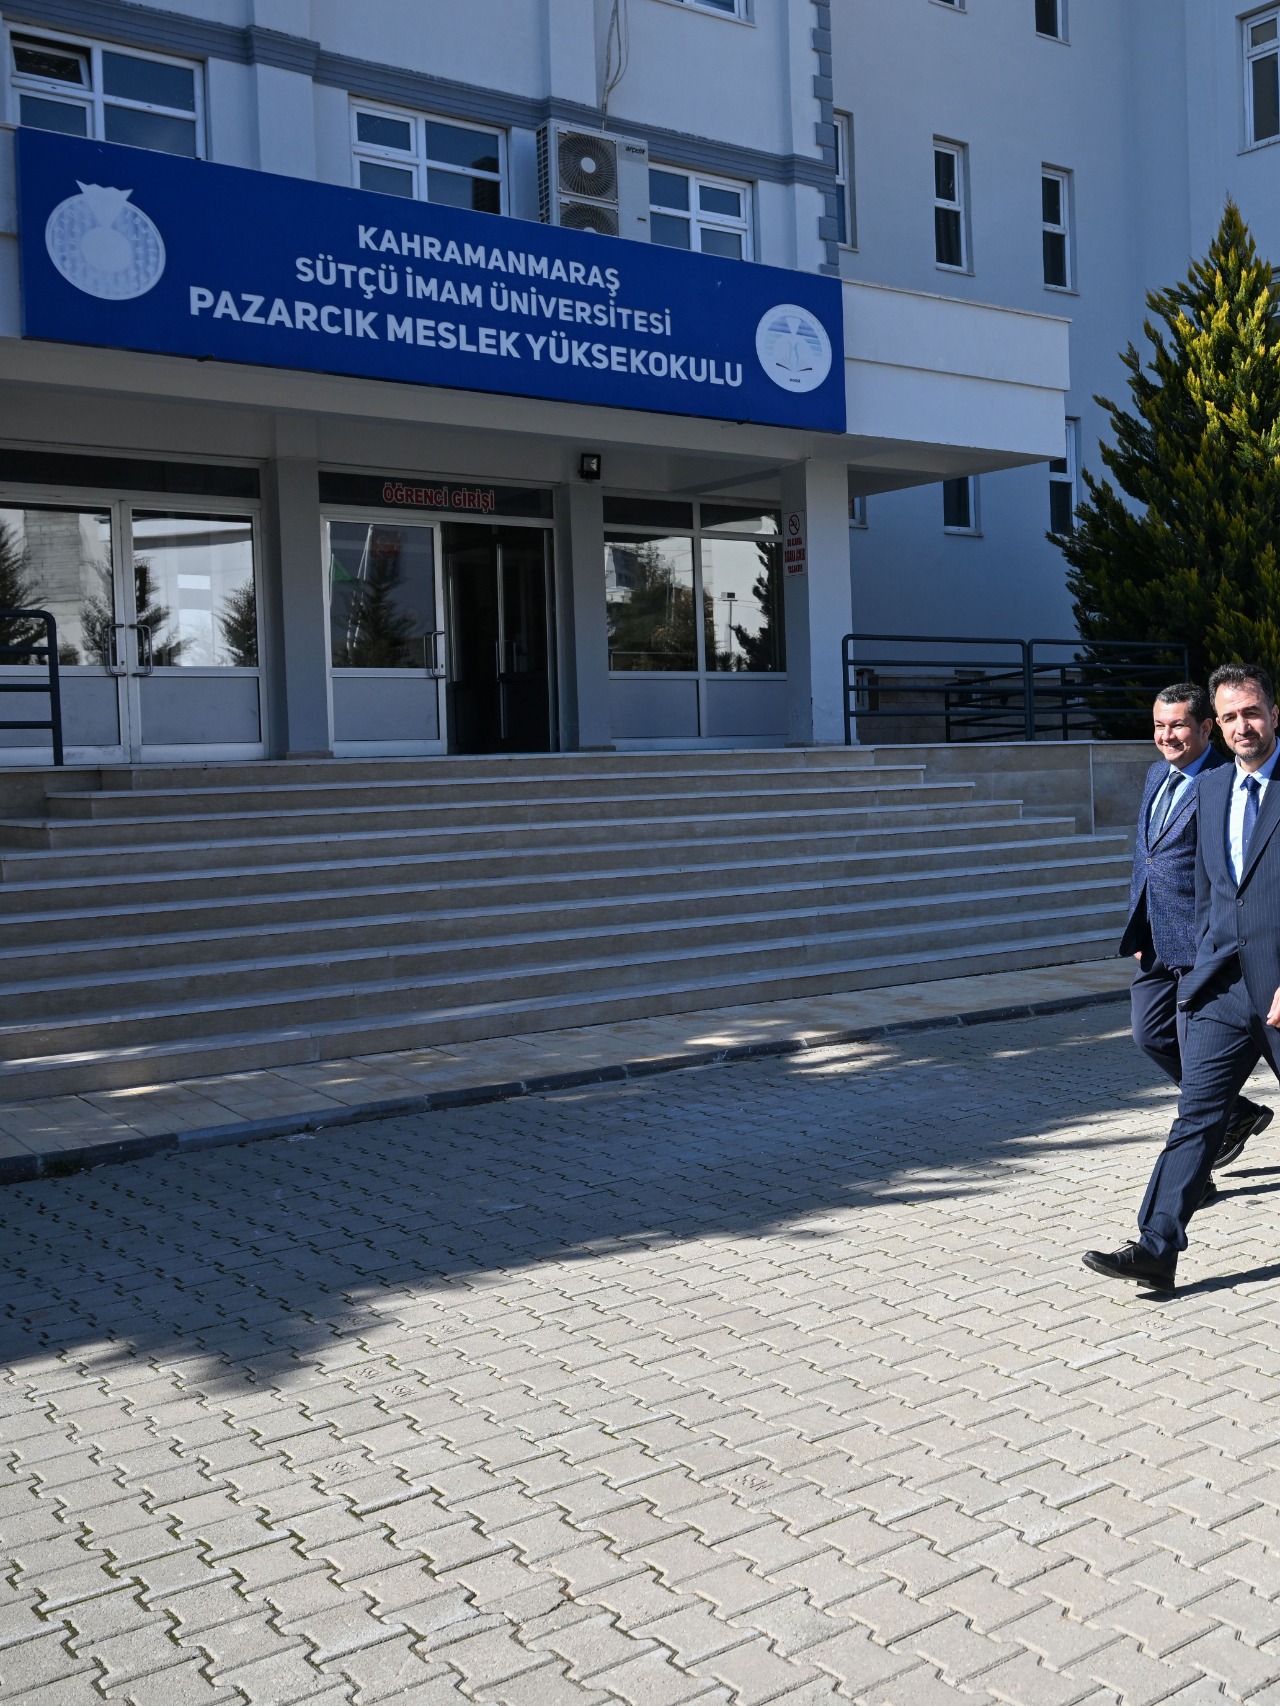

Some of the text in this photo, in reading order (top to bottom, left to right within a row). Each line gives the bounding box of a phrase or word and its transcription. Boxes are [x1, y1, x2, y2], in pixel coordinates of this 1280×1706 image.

[295, 257, 671, 336] SÜTÇÜ İMAM ÜNİVERSİTESİ
[358, 224, 621, 297] KAHRAMANMARAŞ
[189, 286, 743, 387] PAZARCIK MESLEK YÜKSEKOKULU
[383, 482, 495, 513] ÖĞRENCİ GİRİŞİ
